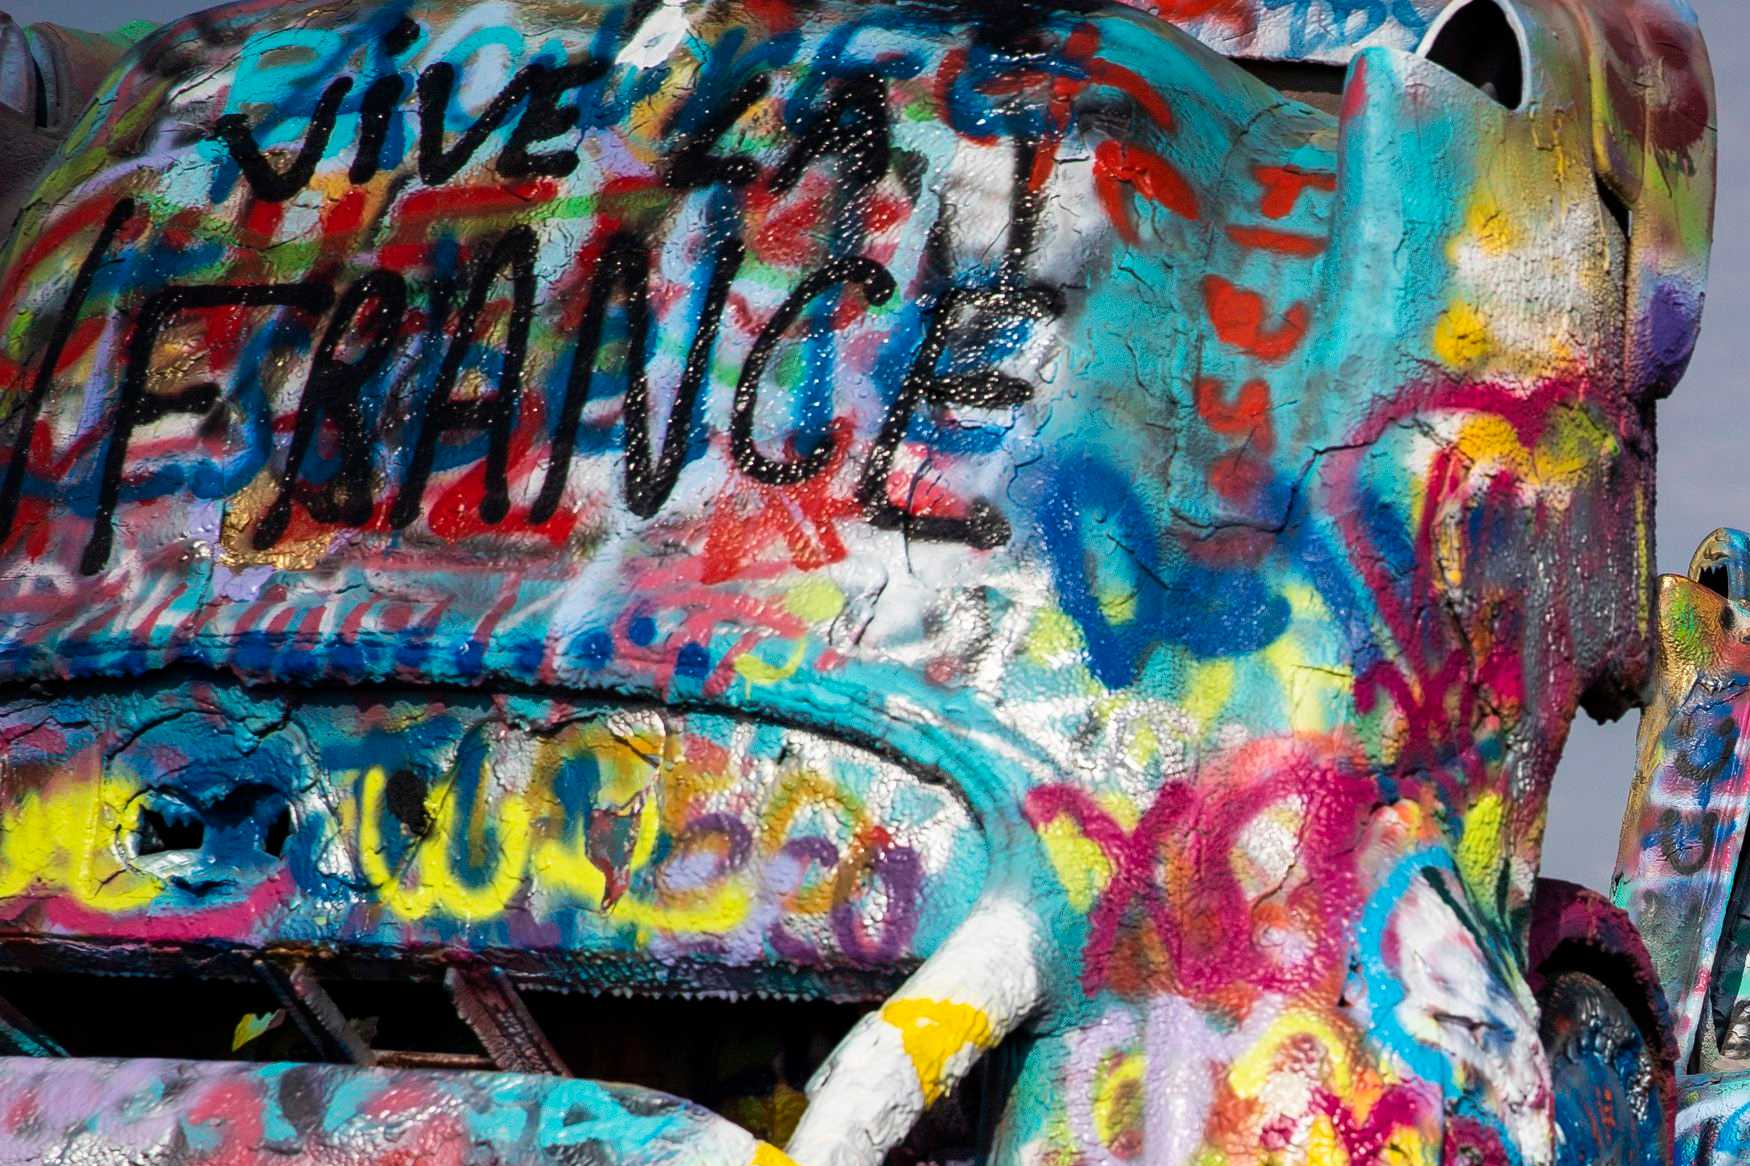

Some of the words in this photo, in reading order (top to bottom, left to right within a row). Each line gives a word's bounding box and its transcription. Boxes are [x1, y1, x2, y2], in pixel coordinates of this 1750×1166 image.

[213, 56, 608, 201] VIVE
[665, 68, 892, 193] LA
[82, 225, 1066, 576] FRANCE
